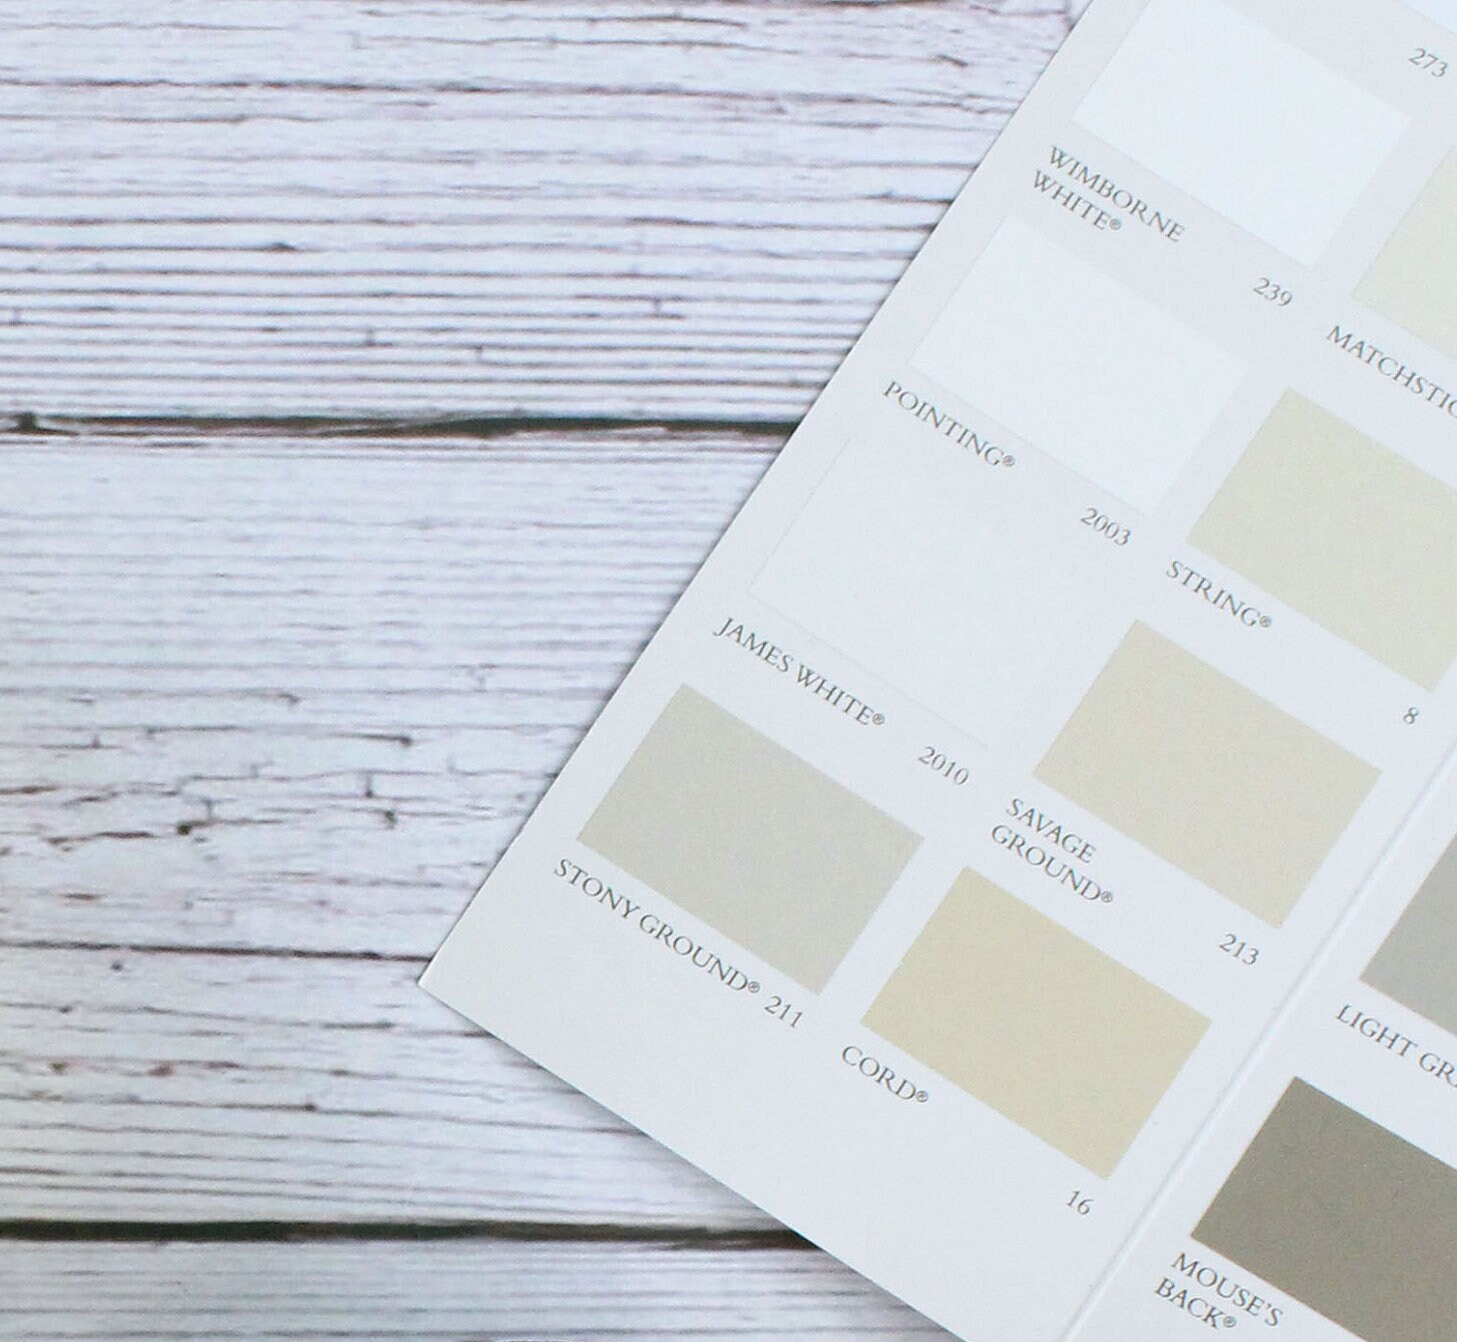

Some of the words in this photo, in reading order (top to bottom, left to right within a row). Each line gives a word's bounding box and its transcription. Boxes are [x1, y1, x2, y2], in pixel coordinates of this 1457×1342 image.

[1408, 47, 1448, 77] 273
[1048, 146, 1185, 243] WIMBORNE
[1253, 276, 1293, 308] 239
[1080, 507, 1132, 546] 2003
[713, 617, 794, 675] JAMES
[1403, 706, 1420, 725] 8
[917, 745, 969, 787] 2010
[1005, 798, 1097, 864] SAVAGE
[553, 858, 640, 920] STONY
[764, 995, 804, 1029] 211
[1219, 933, 1260, 966] 213
[1336, 1004, 1418, 1057] LIGHT
[1065, 1189, 1094, 1217] 16
[1170, 1252, 1284, 1328] MOUSE'S
